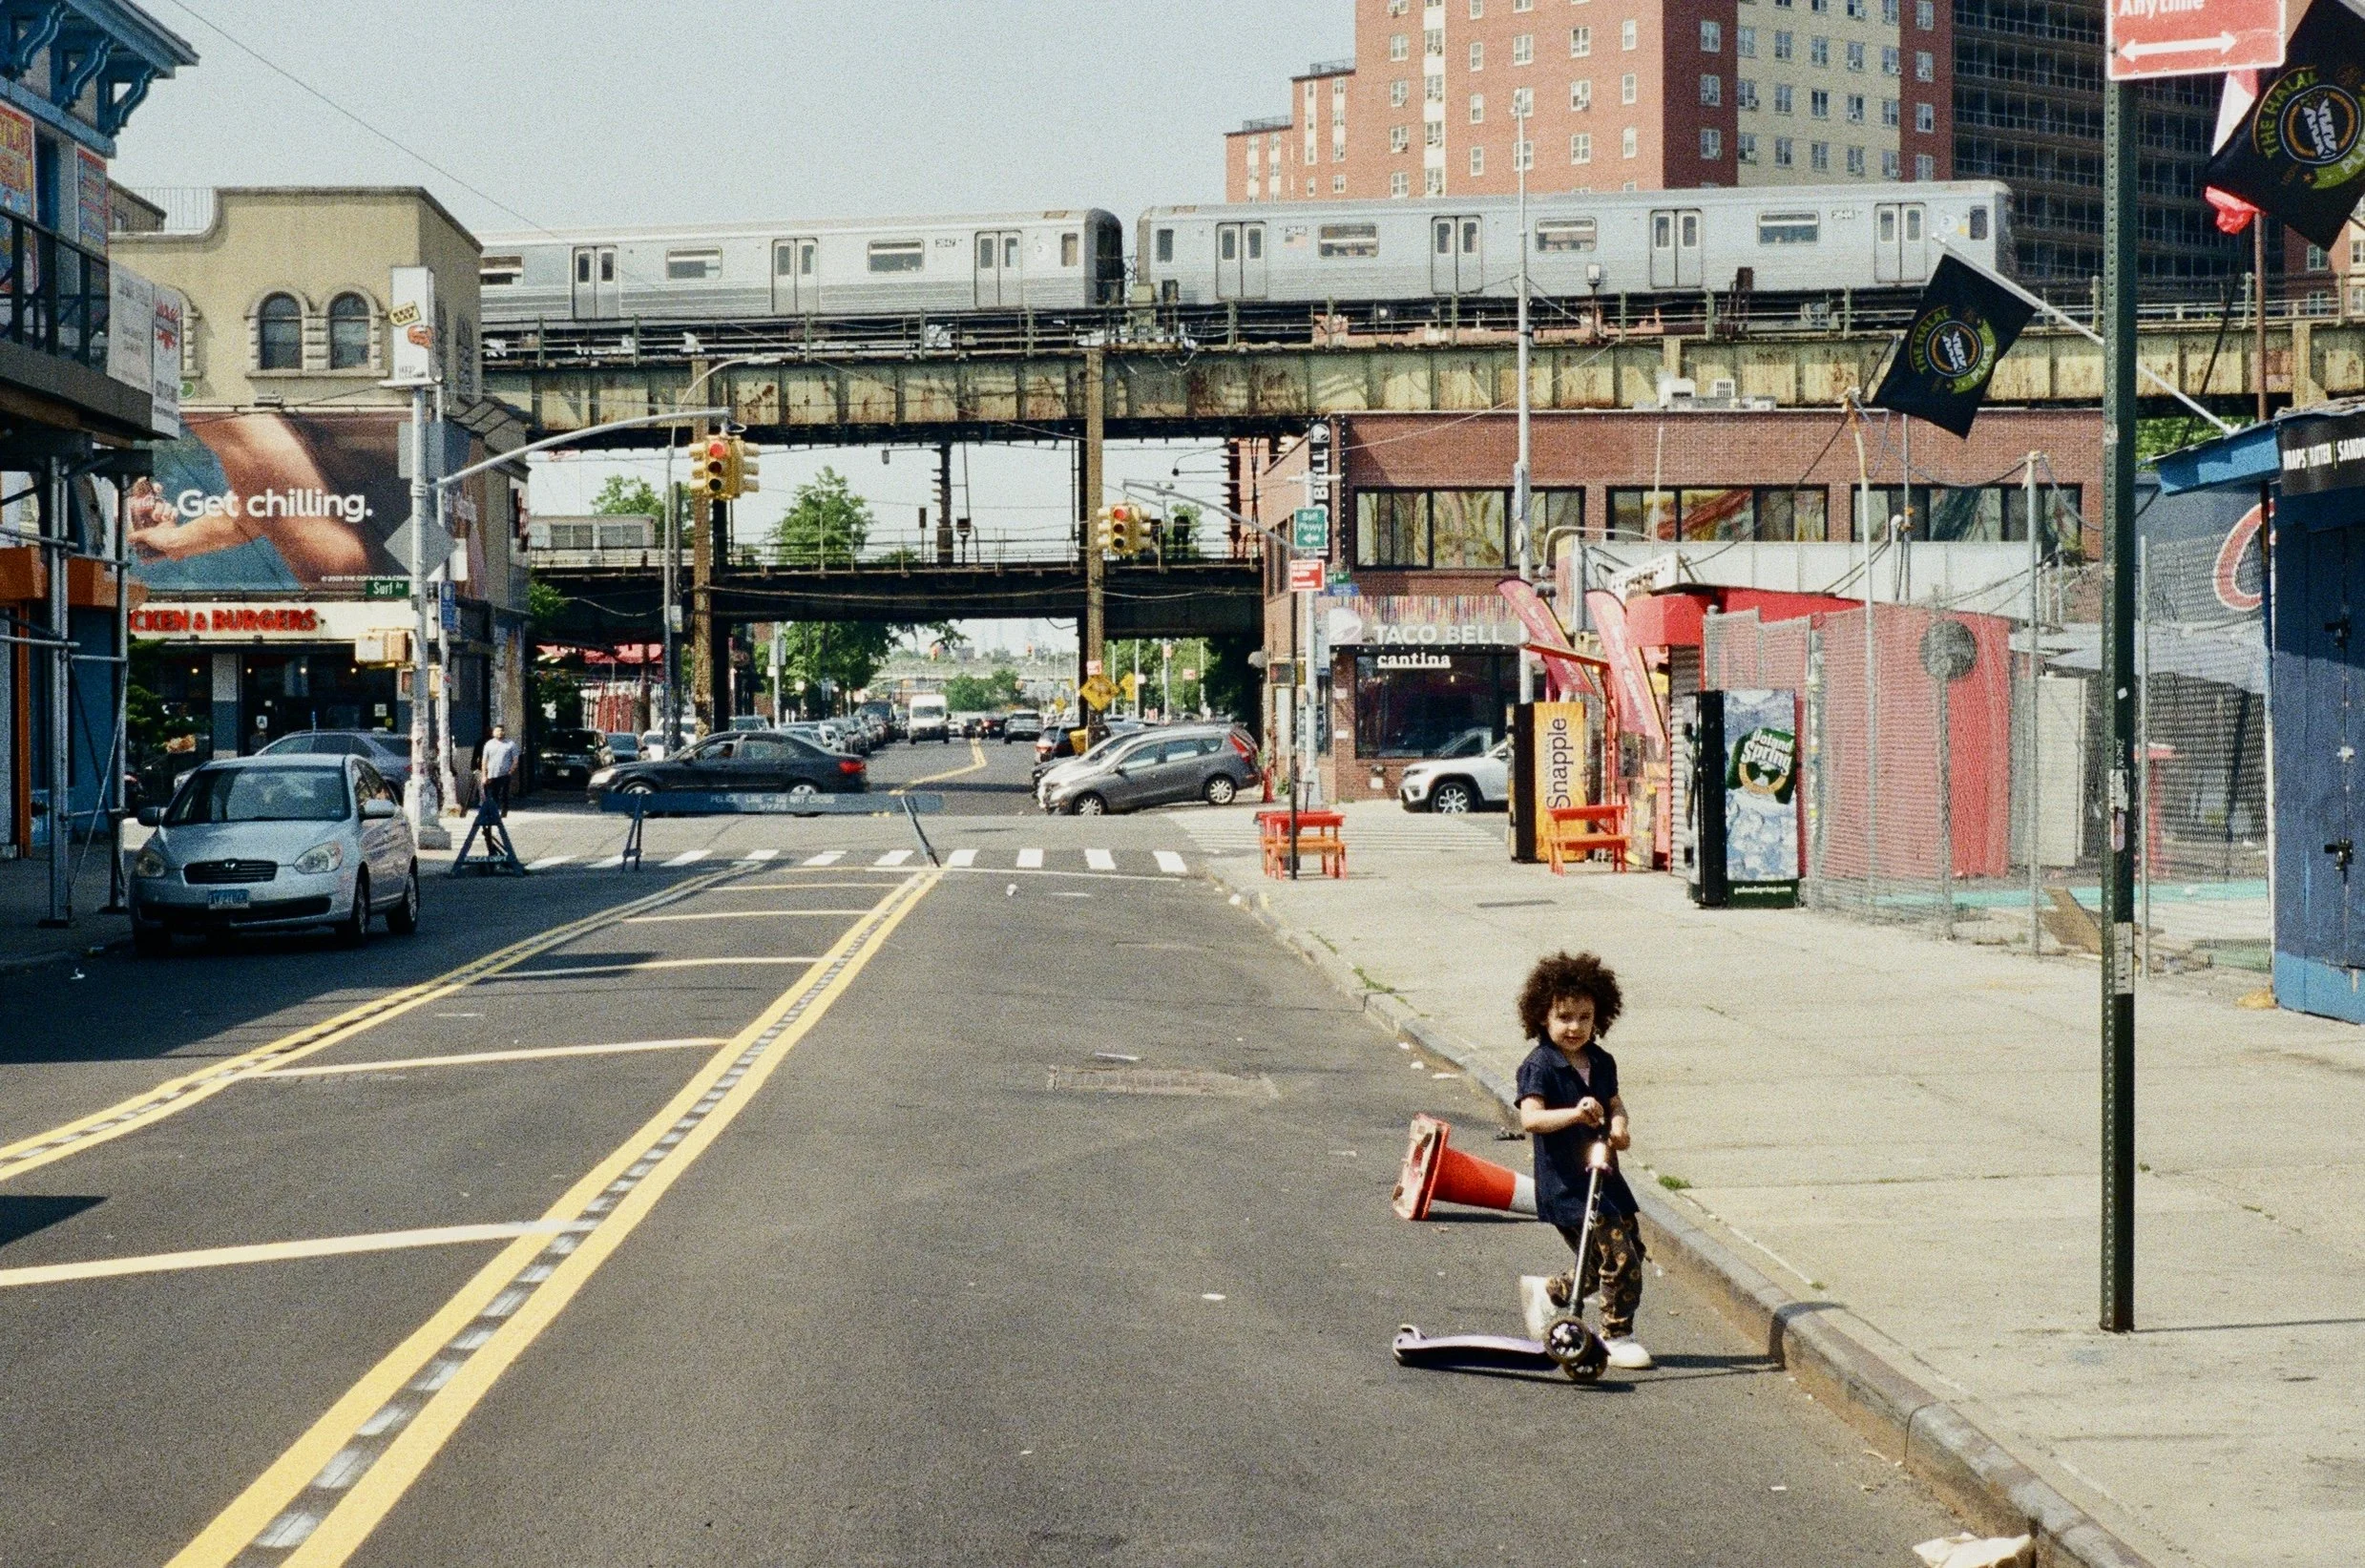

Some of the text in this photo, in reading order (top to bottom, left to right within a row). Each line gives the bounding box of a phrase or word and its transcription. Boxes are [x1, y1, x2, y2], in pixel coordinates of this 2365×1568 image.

[2260, 71, 2319, 159] THE HALAL
[1913, 308, 1952, 375] THE HALAL
[177, 488, 374, 523] Get chilling.
[373, 581, 393, 596] Surf
[192, 612, 207, 631] &
[211, 608, 318, 632] BURGERS
[1372, 625, 1505, 645] TACO BELL
[1376, 652, 1451, 668] cantina
[1750, 729, 1793, 754] Poland
[1546, 718, 1575, 809] Snapple
[1740, 740, 1792, 776] Spring
